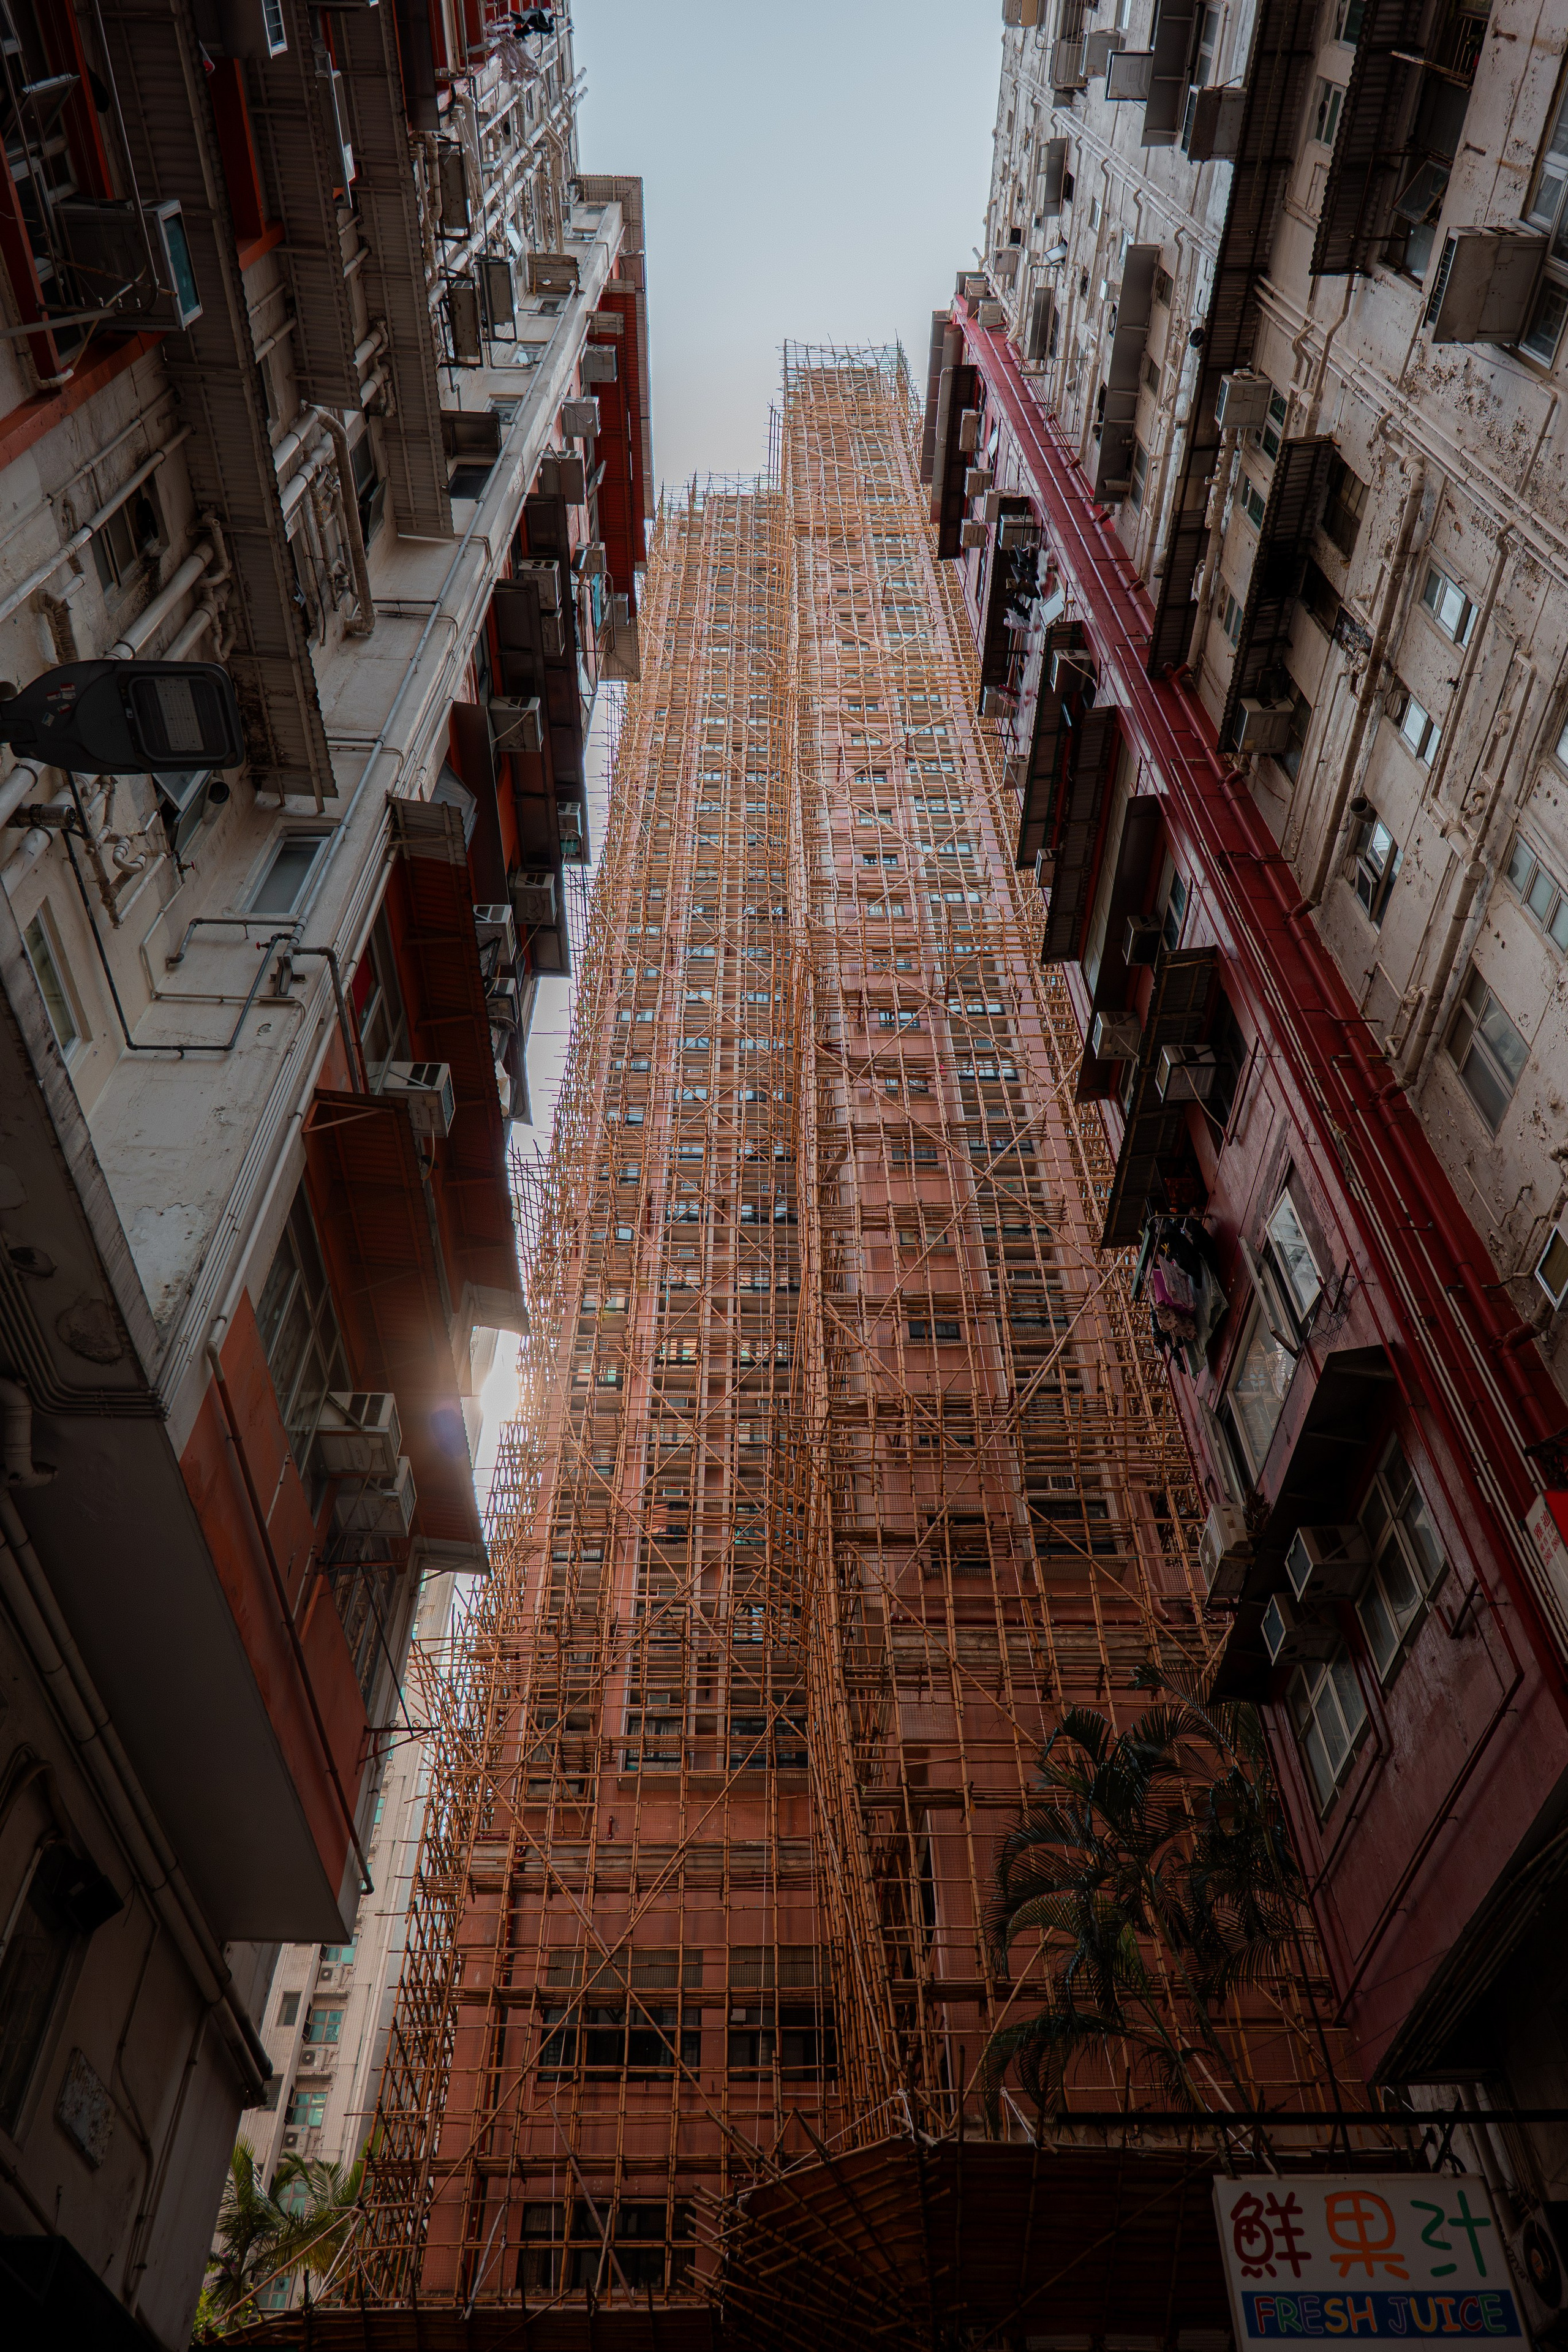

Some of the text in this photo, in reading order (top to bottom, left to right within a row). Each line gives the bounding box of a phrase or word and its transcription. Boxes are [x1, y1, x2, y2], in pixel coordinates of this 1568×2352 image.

[1230, 2189, 1491, 2280] 鮮果汁
[1253, 2294, 1507, 2334] FRESH JUICE
